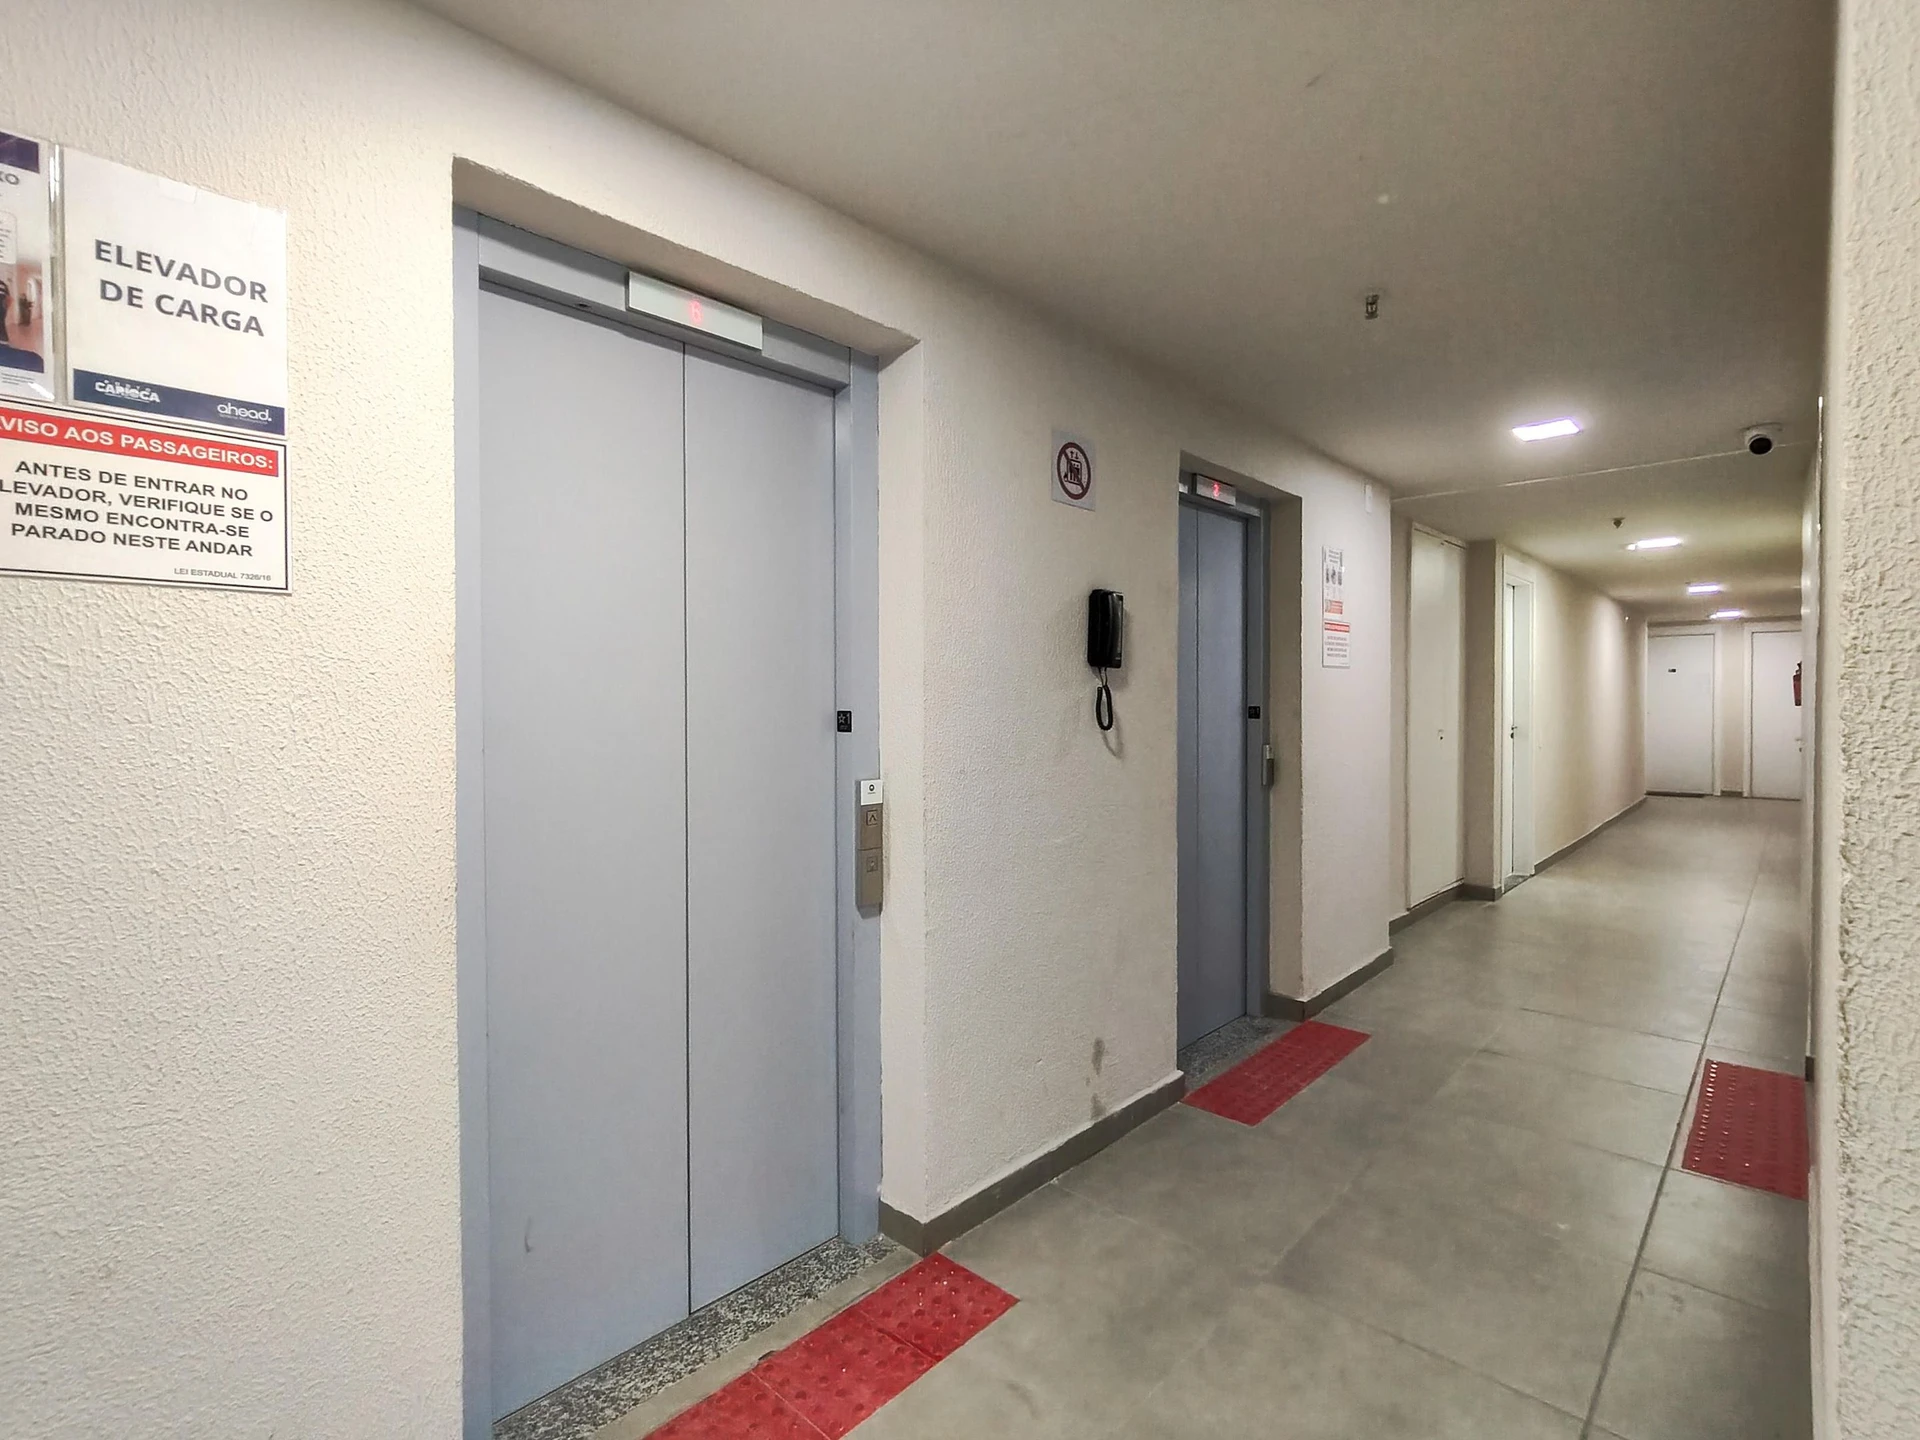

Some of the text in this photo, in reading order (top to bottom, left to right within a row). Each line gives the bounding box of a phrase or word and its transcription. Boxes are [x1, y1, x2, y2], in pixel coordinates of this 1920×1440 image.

[95, 238, 268, 303] ELEVADOR
[100, 279, 265, 337] DE CARGA
[95, 382, 160, 403] CARIOCA
[0, 415, 274, 469] VISO AOS PASSAGEIROS:
[15, 461, 248, 501] ANTES DE ENTRAR NO
[15, 502, 250, 539] MESMO ENCONTRA-SE
[119, 493, 225, 518] VERIFIQUE
[231, 507, 255, 521] SE
[260, 510, 274, 522] O
[11, 523, 253, 557] PARADO NESTE ANDAR
[190, 569, 238, 579] ESTADUAL
